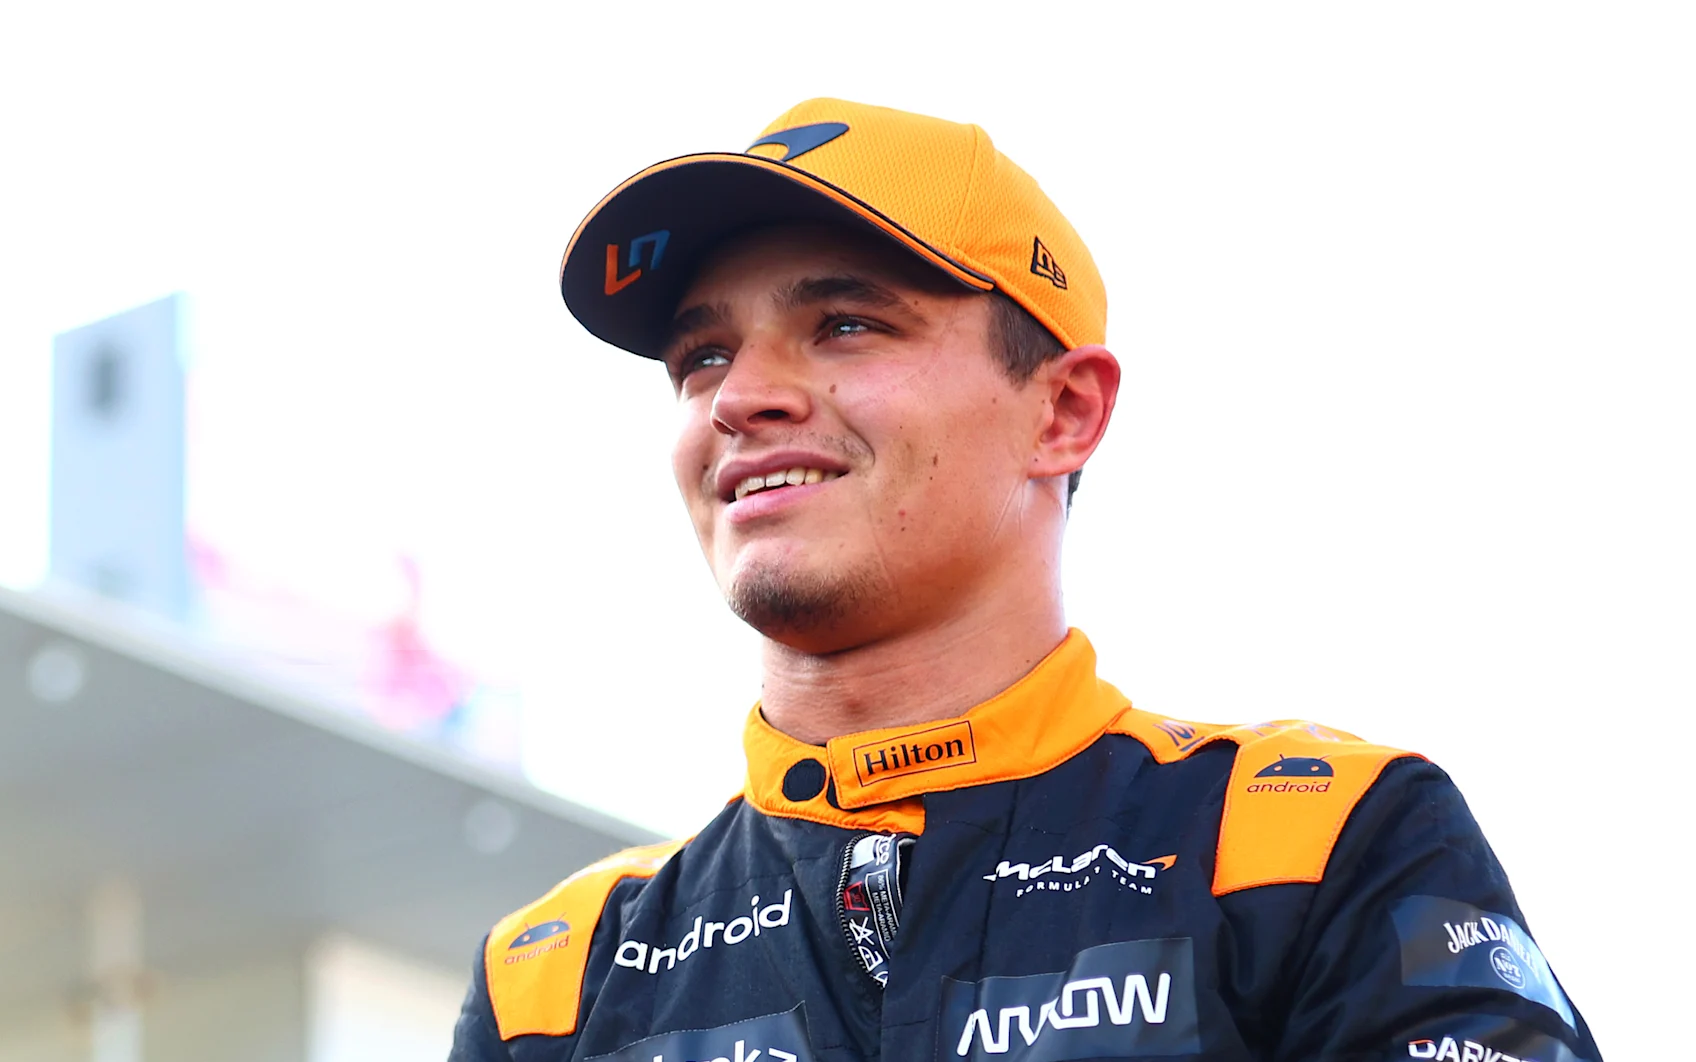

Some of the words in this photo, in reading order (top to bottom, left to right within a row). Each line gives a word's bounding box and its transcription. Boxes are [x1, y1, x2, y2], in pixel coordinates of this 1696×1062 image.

[863, 735, 965, 778] Hilton
[1247, 781, 1331, 793] android
[983, 844, 1157, 881] McLaren
[1016, 875, 1090, 898] FORMULA
[1111, 869, 1153, 895] TEAM
[614, 889, 792, 974] android
[880, 890, 898, 938] META-ARAM
[504, 934, 570, 966] android
[1443, 921, 1489, 954] JACK
